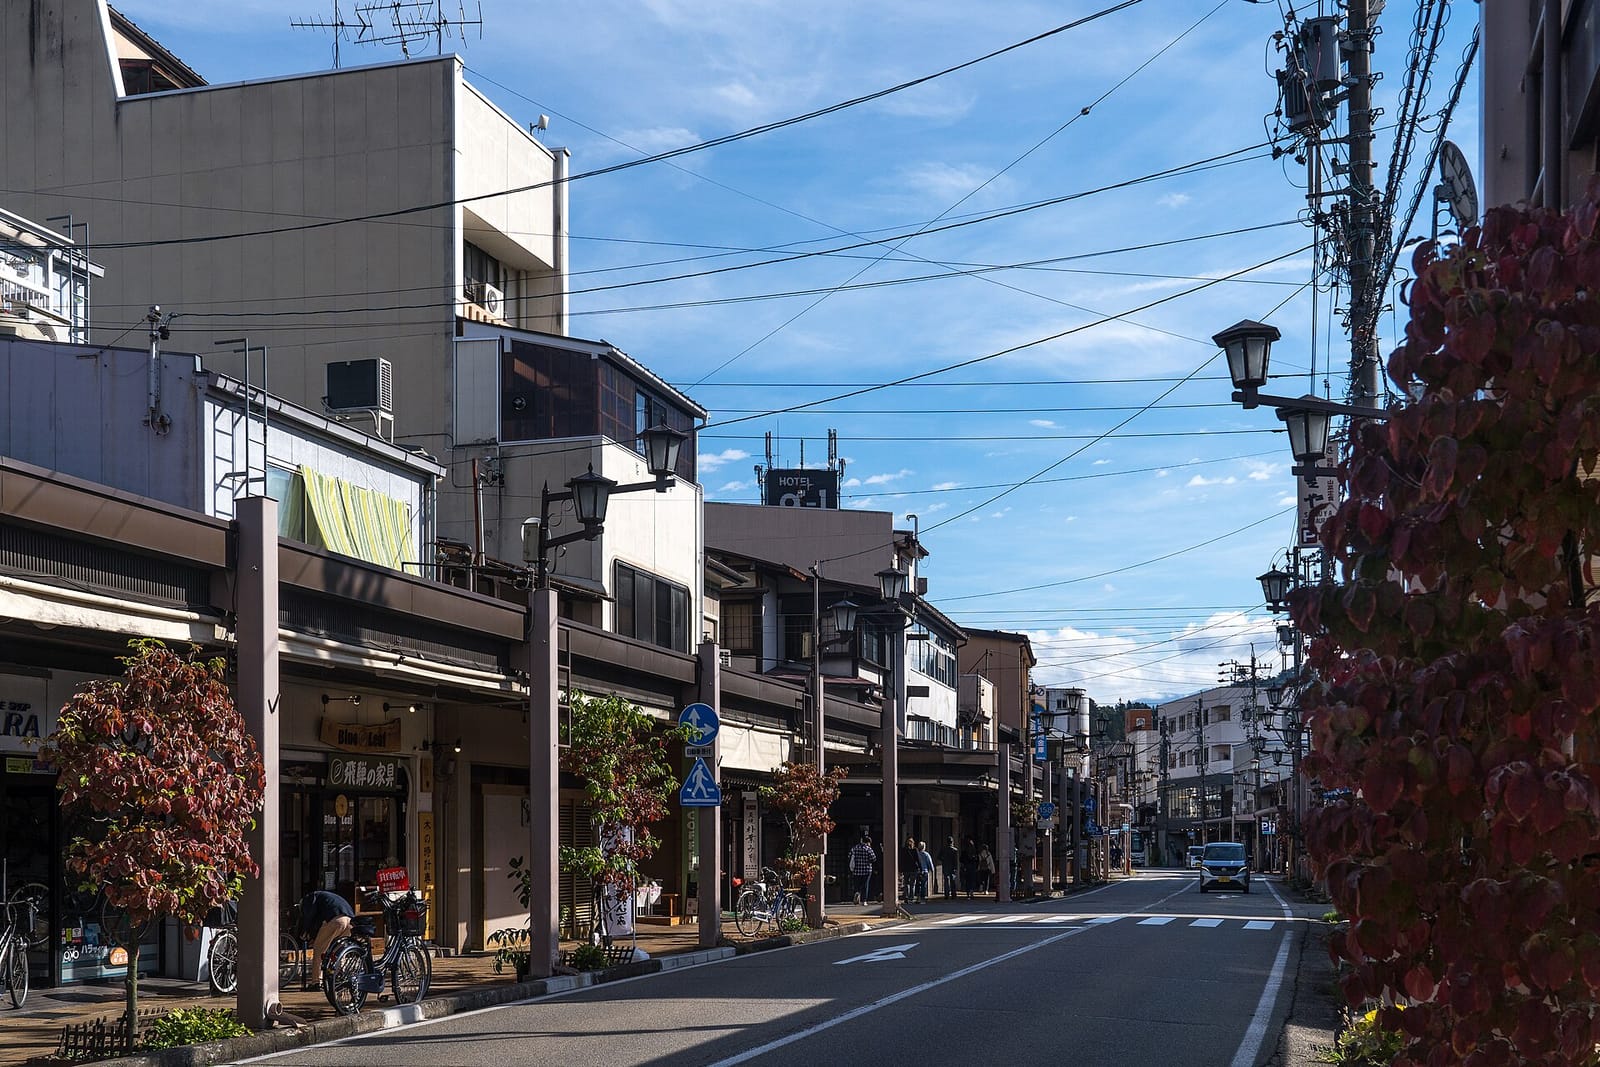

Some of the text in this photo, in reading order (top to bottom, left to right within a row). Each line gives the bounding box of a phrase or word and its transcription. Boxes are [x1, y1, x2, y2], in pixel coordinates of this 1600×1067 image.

[778, 476, 814, 488] HOTEL
[1303, 529, 1316, 543] P
[0, 712, 40, 737] RA
[338, 730, 387, 747] Blue Leaf
[344, 761, 394, 787] 飛騨の家具
[1039, 806, 1053, 814] 158
[323, 814, 353, 825] Blue Leaf
